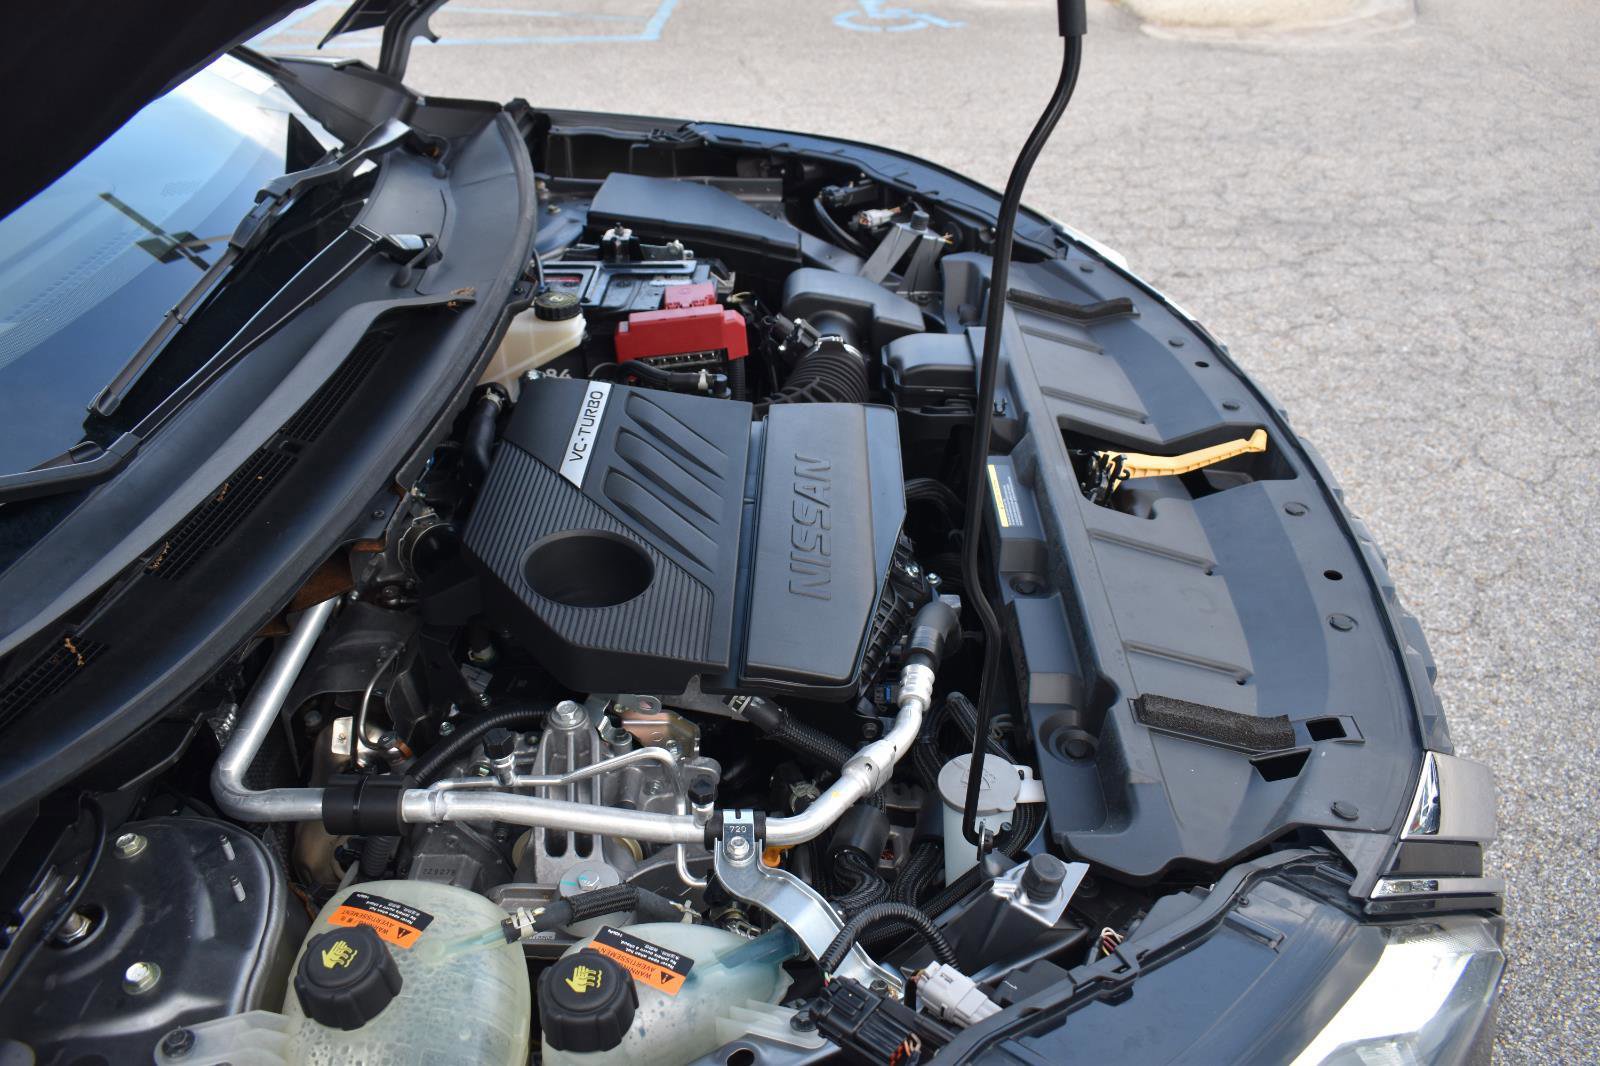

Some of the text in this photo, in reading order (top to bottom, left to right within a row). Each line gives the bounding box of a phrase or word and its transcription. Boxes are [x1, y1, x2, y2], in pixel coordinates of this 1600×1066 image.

[789, 453, 831, 600] NISSAN
[729, 825, 747, 833] 720
[599, 946, 656, 973] AVERTISSEMEN
